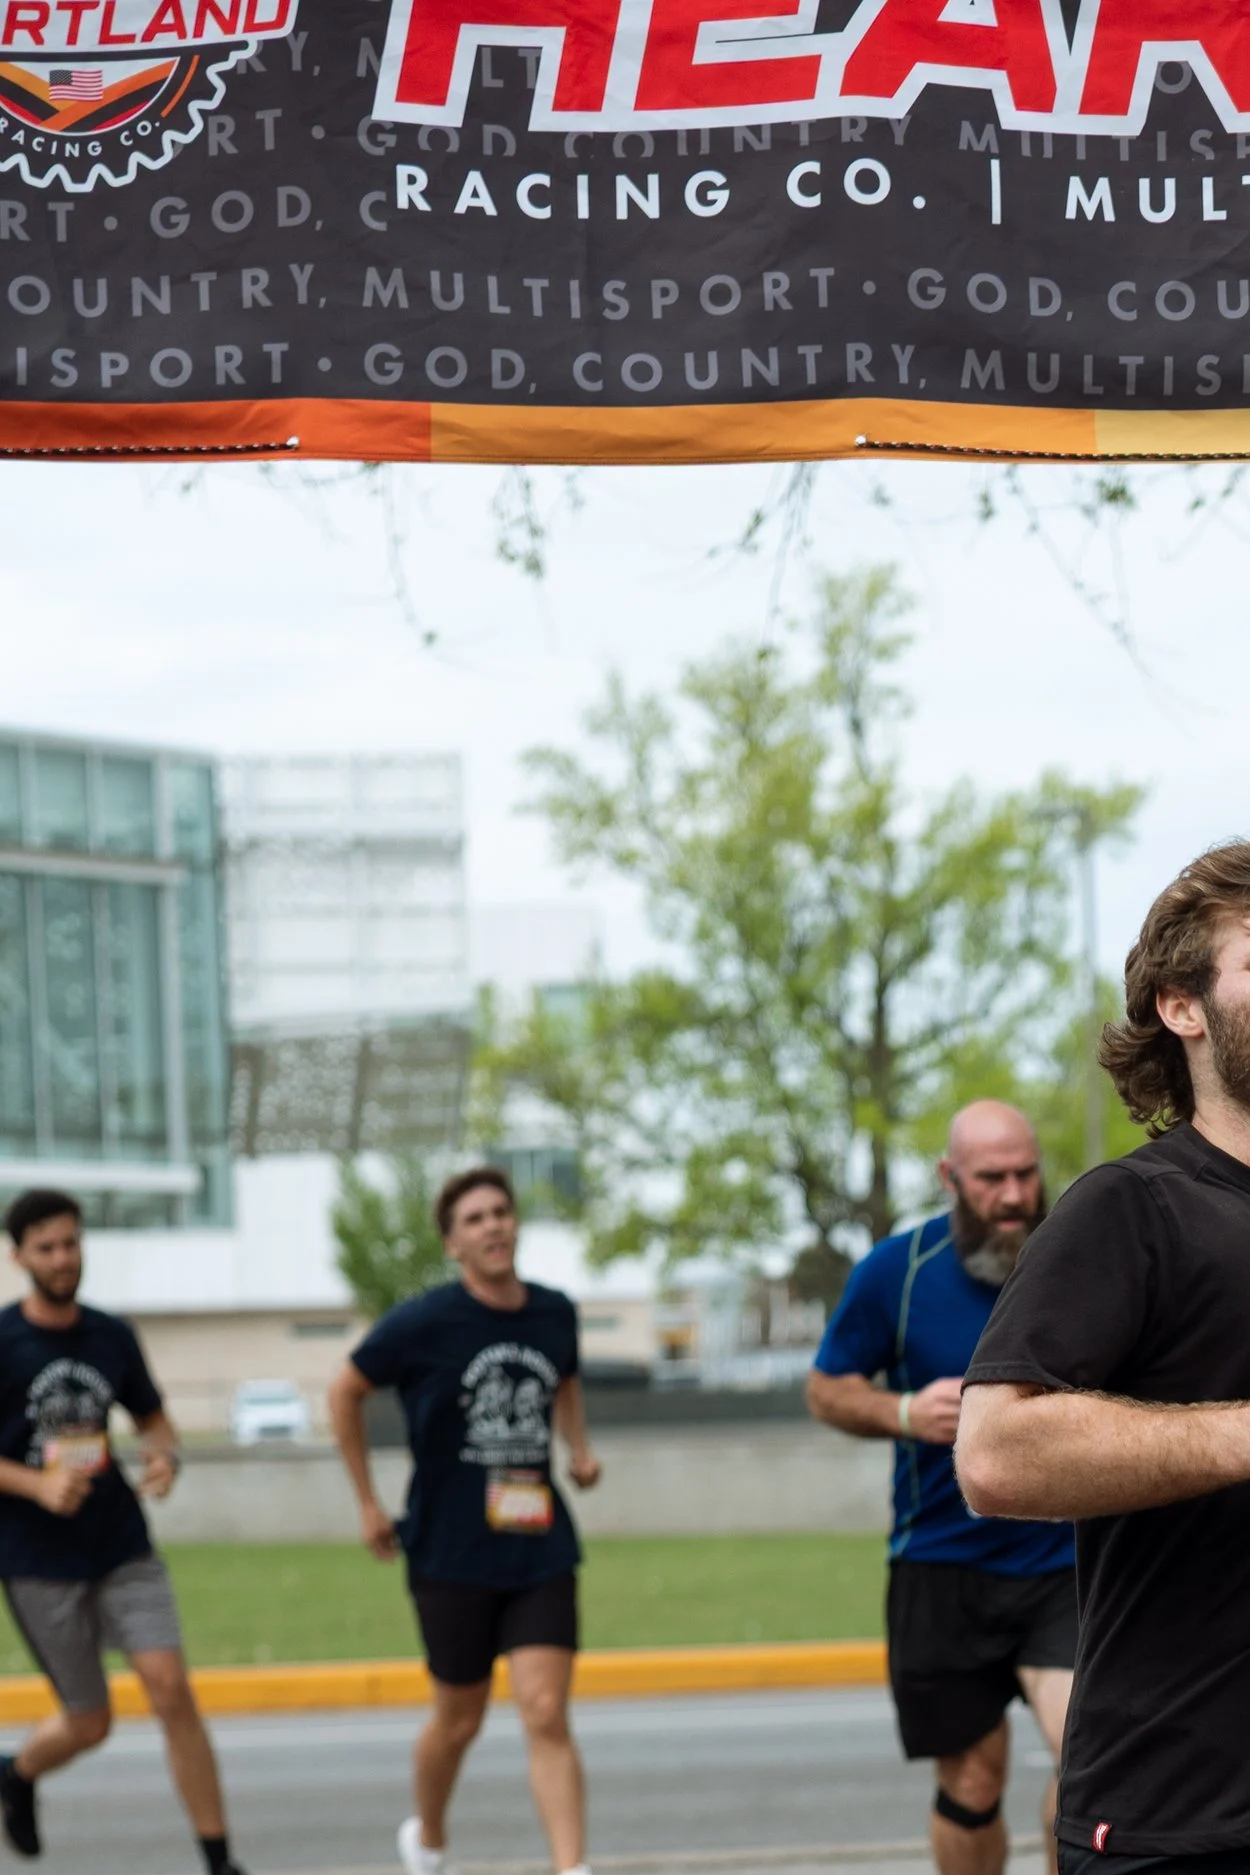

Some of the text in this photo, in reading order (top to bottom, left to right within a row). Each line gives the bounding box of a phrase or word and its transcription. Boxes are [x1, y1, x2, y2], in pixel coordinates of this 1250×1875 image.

[396, 164, 730, 220] RACING
[786, 158, 927, 211] CO.
[8, 264, 326, 319] OUNTRY,
[363, 266, 835, 320] MULTISPORT
[907, 268, 1073, 321] GOD,
[16, 343, 289, 388] ISPORT
[364, 343, 537, 393] GOD,
[572, 342, 927, 393] COUNTRY,
